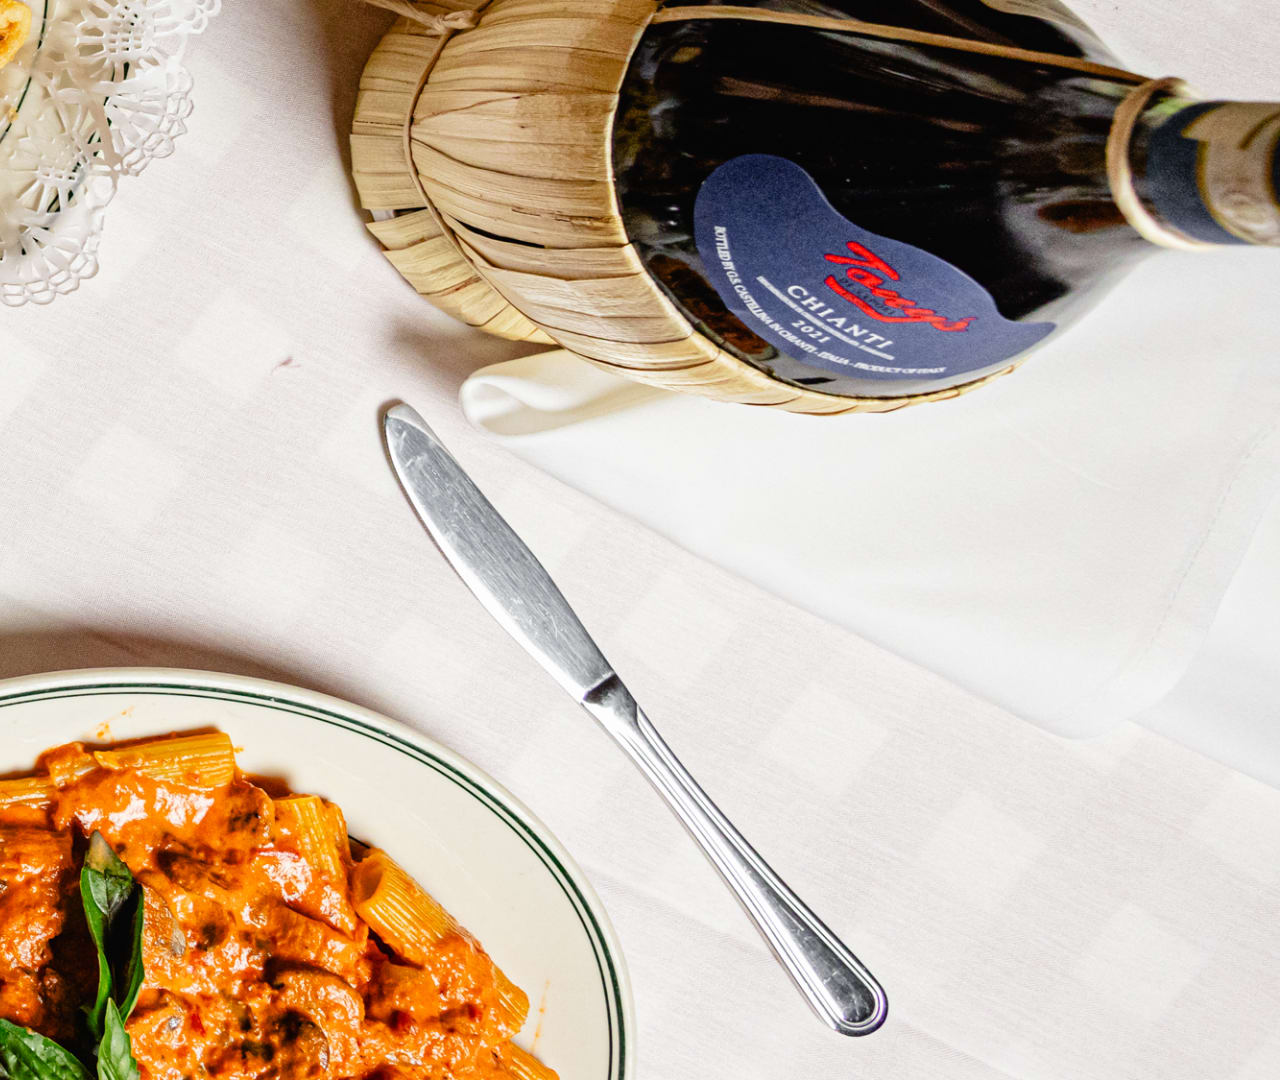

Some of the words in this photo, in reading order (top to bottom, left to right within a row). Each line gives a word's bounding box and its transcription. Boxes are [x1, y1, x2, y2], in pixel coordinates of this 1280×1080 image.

[714, 225, 731, 262] BOTTLED
[721, 260, 735, 271] BY
[734, 284, 774, 325] CASTELLINA
[769, 322, 783, 332] IN
[787, 285, 893, 349] CHIANTI
[779, 329, 817, 353] CHIANTI
[791, 320, 831, 344] 2021
[817, 351, 849, 365] ITALIA
[853, 362, 902, 374] PRODUCT
